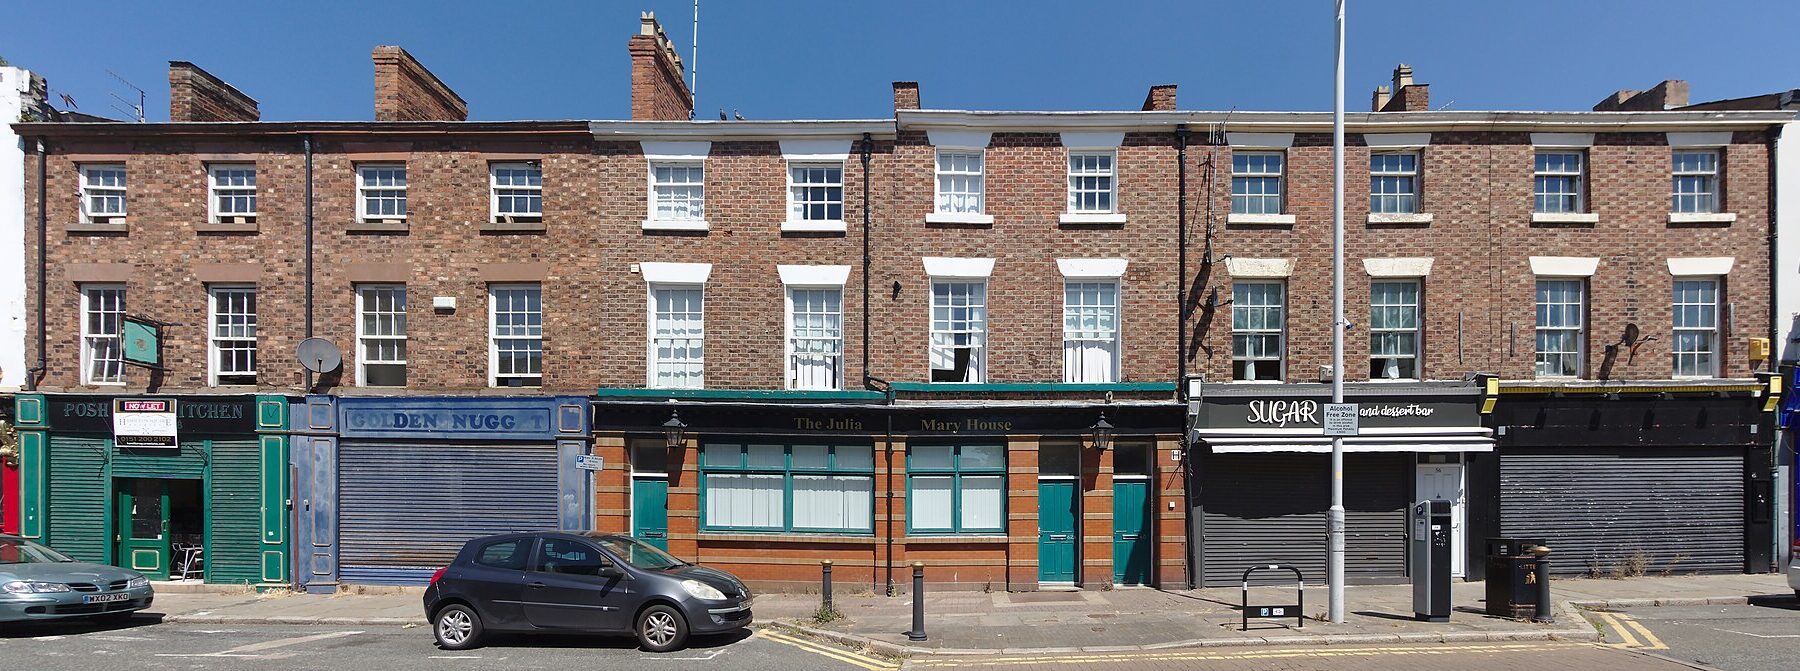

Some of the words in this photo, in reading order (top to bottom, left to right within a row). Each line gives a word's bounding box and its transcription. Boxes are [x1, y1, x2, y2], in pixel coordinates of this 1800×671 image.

[64, 402, 109, 418] POSH
[176, 403, 243, 419] ITCHEN
[1247, 399, 1320, 428] SUGAR
[1359, 405, 1380, 417] and
[1380, 405, 1414, 418] dessert
[1414, 403, 1434, 416] bar
[351, 413, 437, 429] GOLDEN
[452, 413, 545, 430] NUGGT
[793, 417, 822, 430] The
[826, 417, 863, 430] Julia
[921, 419, 961, 433] Mary
[966, 418, 1012, 431] House
[1417, 506, 1423, 514] P
